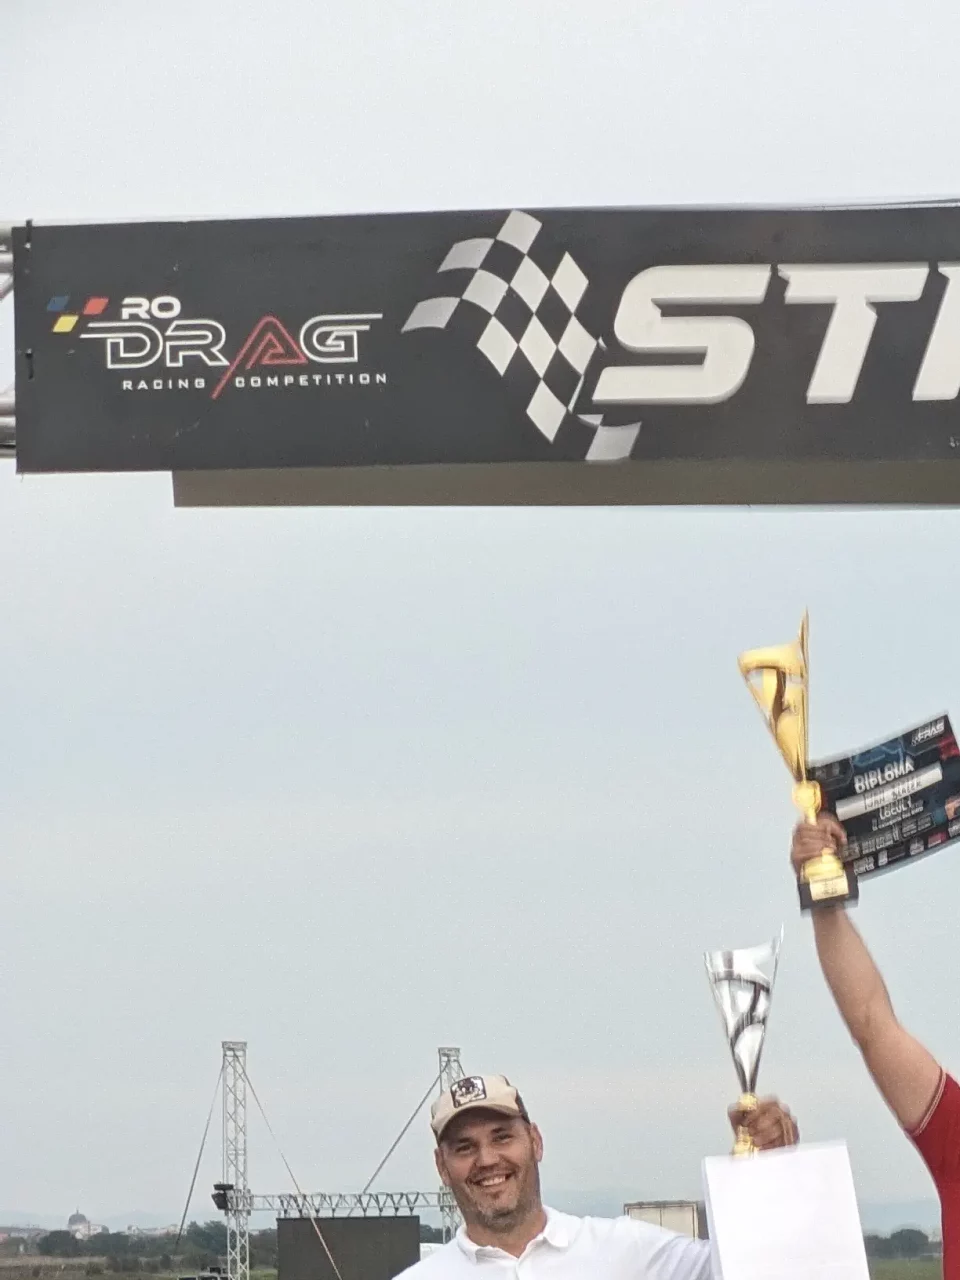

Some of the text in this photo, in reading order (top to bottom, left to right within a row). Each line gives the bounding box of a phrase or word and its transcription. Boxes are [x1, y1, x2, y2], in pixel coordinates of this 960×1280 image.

[121, 296, 181, 319] RO
[80, 312, 384, 398] DRAG
[122, 373, 388, 390] RACING COMPETITION
[854, 760, 915, 794] DIPLOMA
[880, 800, 908, 820] LOCUL
